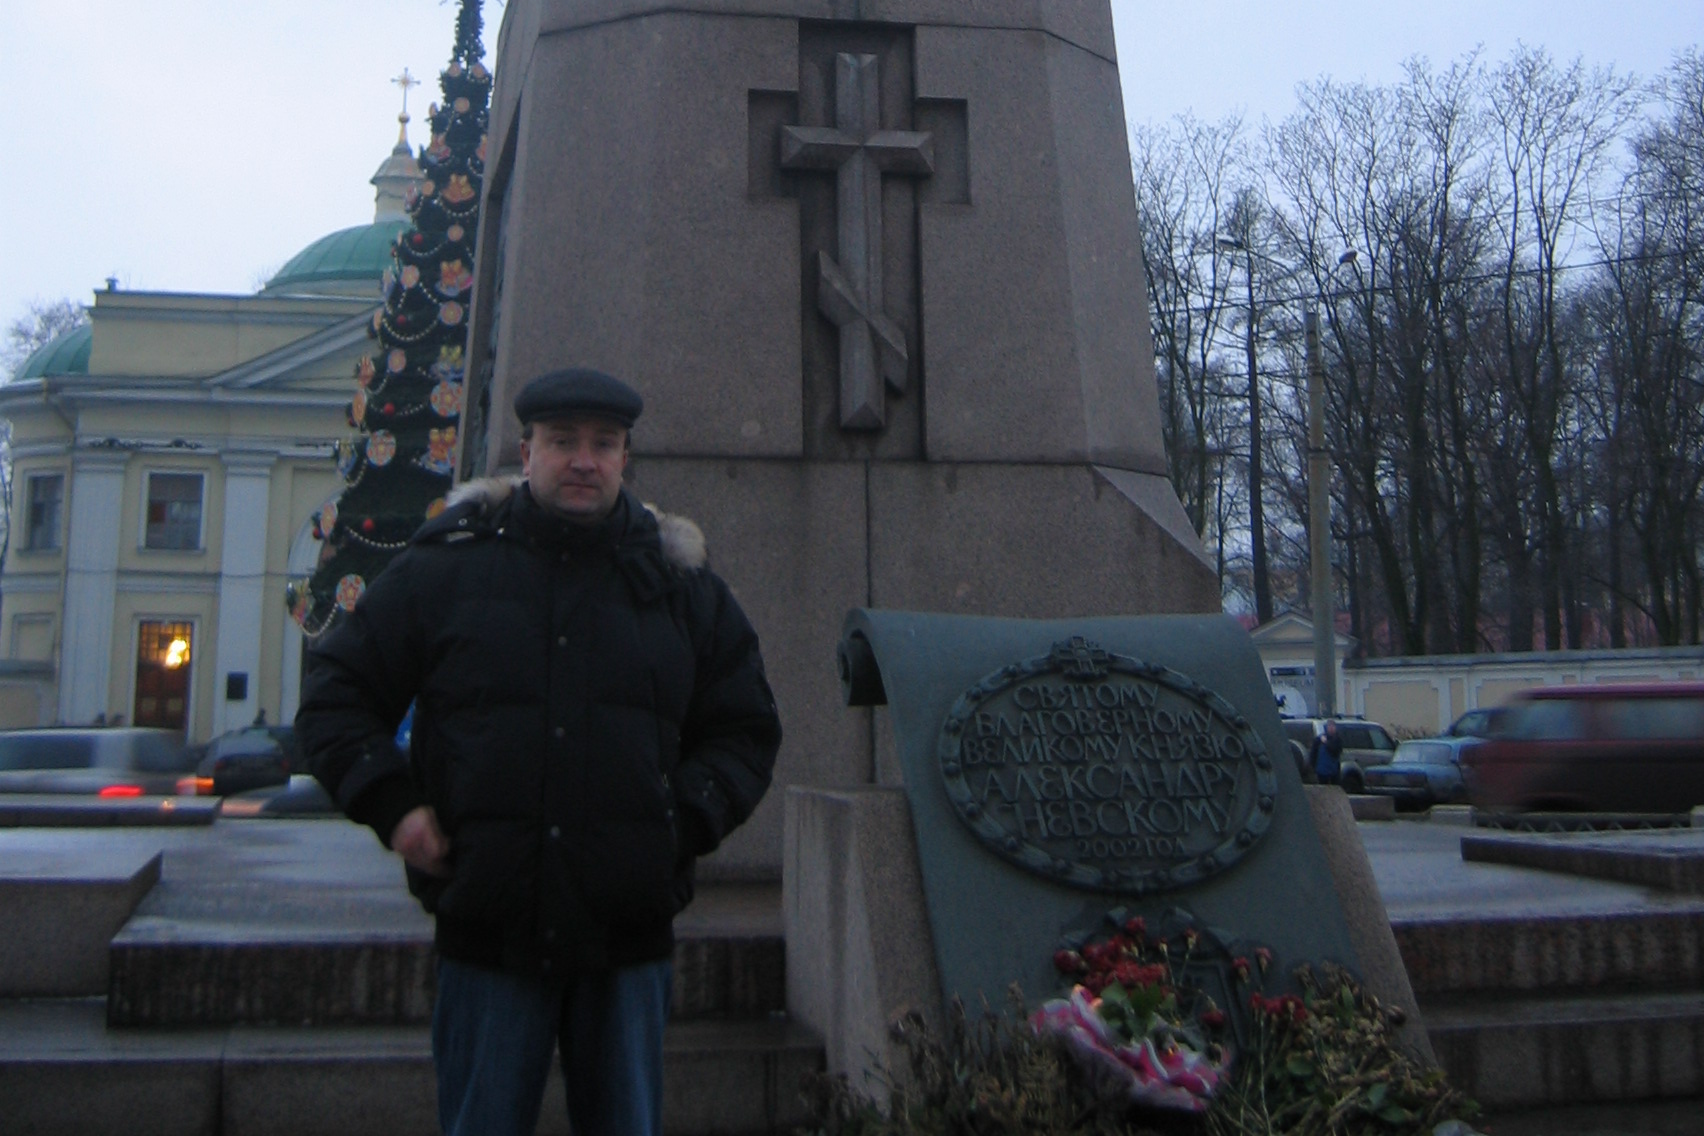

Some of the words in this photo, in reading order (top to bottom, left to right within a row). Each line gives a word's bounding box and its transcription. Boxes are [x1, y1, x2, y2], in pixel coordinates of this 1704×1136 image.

[1013, 683, 1160, 710] СВЯТОМУ
[974, 710, 1213, 737] БЛАГОВЕРНОМУ
[963, 733, 1123, 764] ВЕЛИКОМУ
[1127, 733, 1245, 760] КНЯЗЮ
[982, 763, 1242, 802] АЛЕКСАНДРУ
[1000, 796, 1238, 839] НЕВСКОМУ
[1076, 837, 1141, 859] 2002
